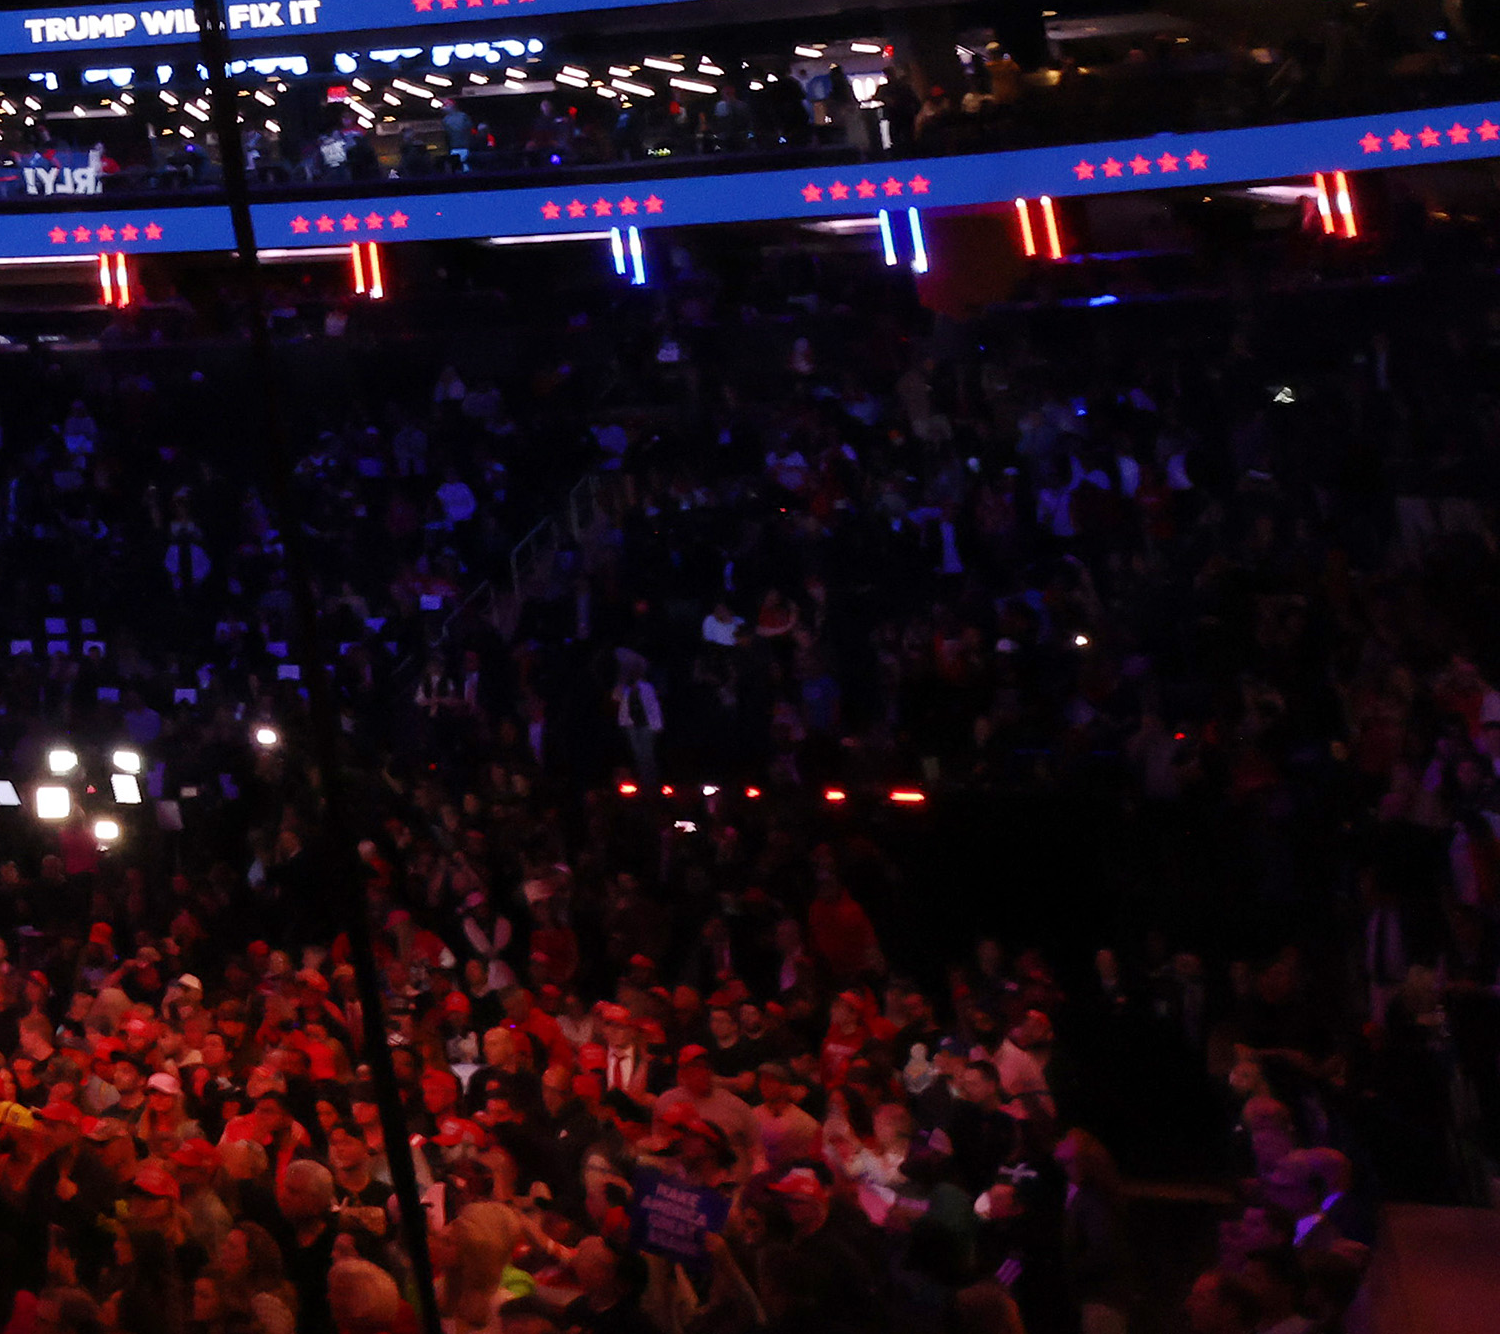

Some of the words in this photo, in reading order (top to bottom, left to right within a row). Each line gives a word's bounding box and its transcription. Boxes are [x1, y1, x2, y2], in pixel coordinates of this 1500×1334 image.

[24, 12, 137, 44] TRUMP
[140, 8, 202, 37] WIL
[227, 1, 284, 30] FIX
[288, 0, 321, 26] IT
